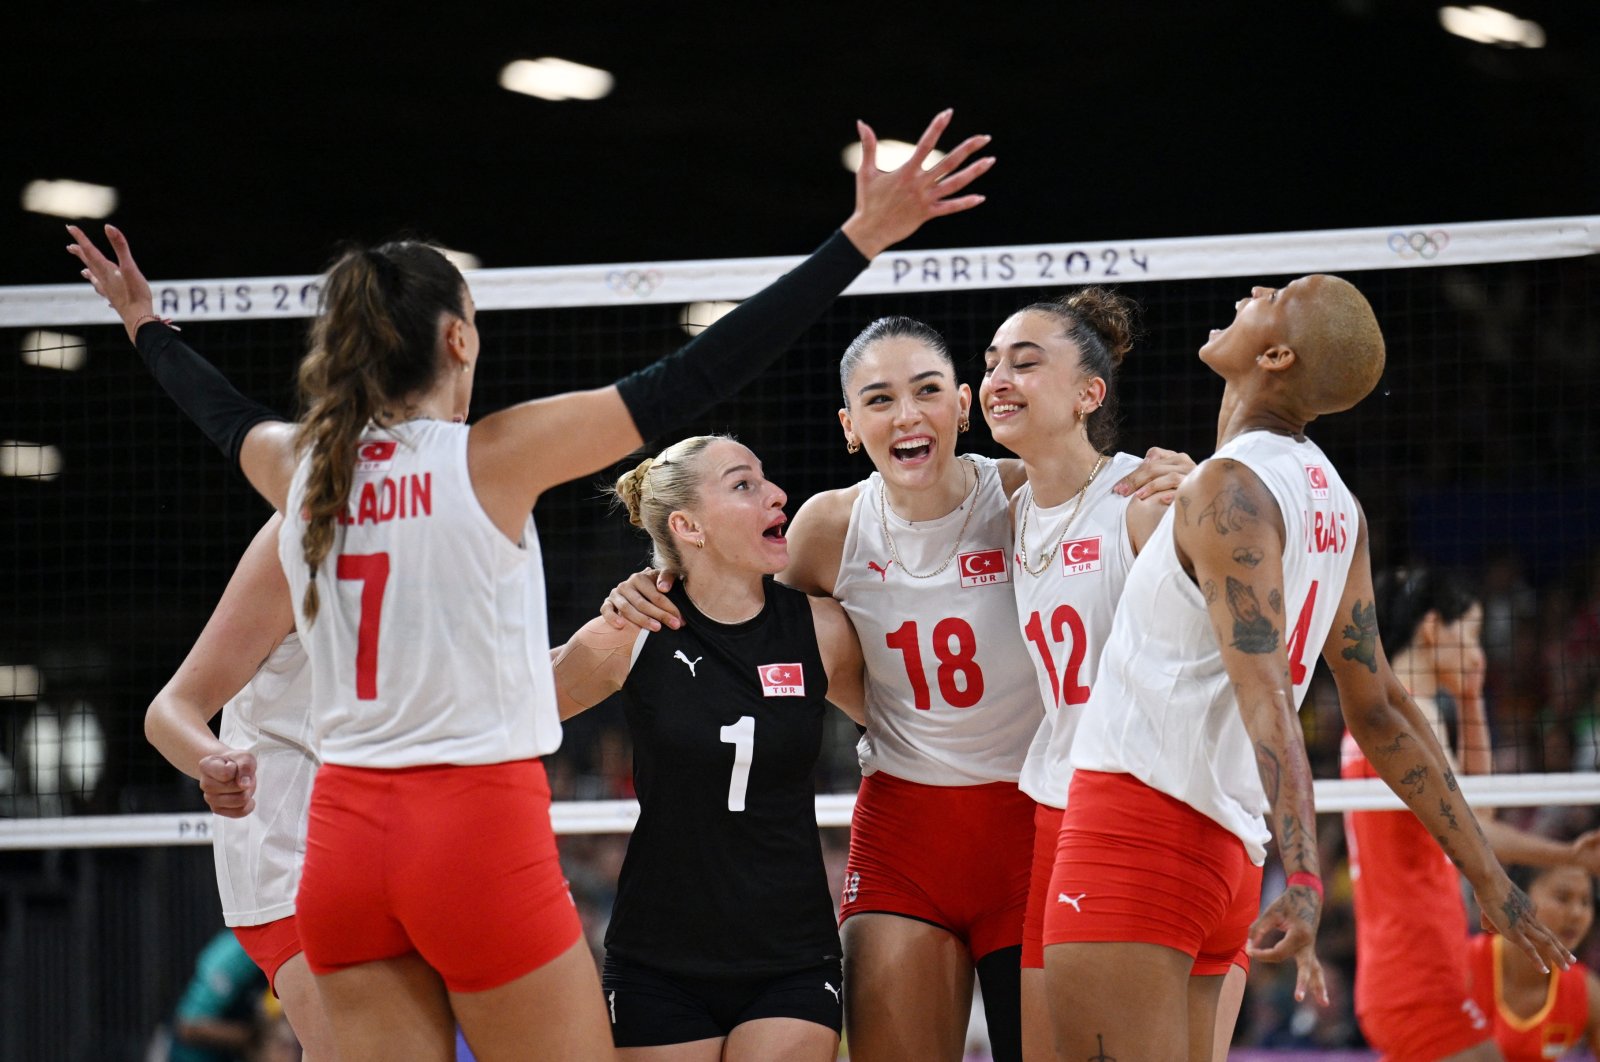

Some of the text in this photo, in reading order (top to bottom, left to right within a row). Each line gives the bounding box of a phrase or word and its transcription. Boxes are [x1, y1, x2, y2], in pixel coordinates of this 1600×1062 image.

[1036, 248, 1148, 279] 2024
[161, 284, 320, 314] ARiS 20
[971, 575, 997, 584] TUR
[1072, 563, 1092, 572] TUR
[337, 552, 390, 701] 7
[1025, 604, 1090, 709] 12
[886, 617, 984, 710] 18
[720, 716, 755, 812] 1
